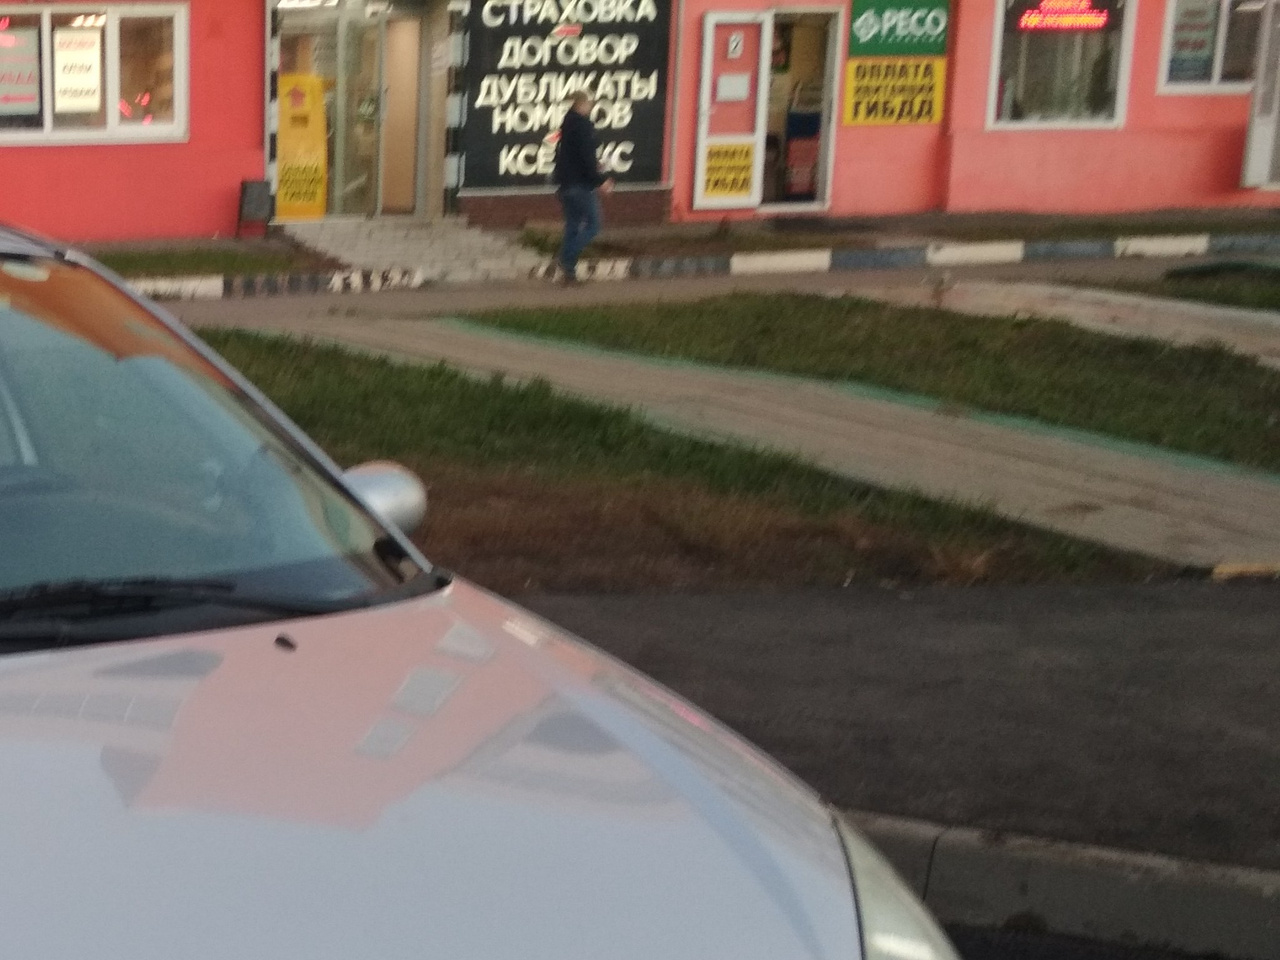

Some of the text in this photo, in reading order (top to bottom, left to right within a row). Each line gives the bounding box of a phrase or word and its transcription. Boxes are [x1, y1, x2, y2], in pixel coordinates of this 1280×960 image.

[482, 0, 658, 27] СТРАХОВКА
[880, 7, 947, 36] РЕСО
[497, 33, 640, 70] ДОГОВОР
[855, 64, 933, 79] ОПЛАТА
[475, 69, 659, 109] ДУБЛИКАТЫ
[852, 100, 934, 122] ГИБДД
